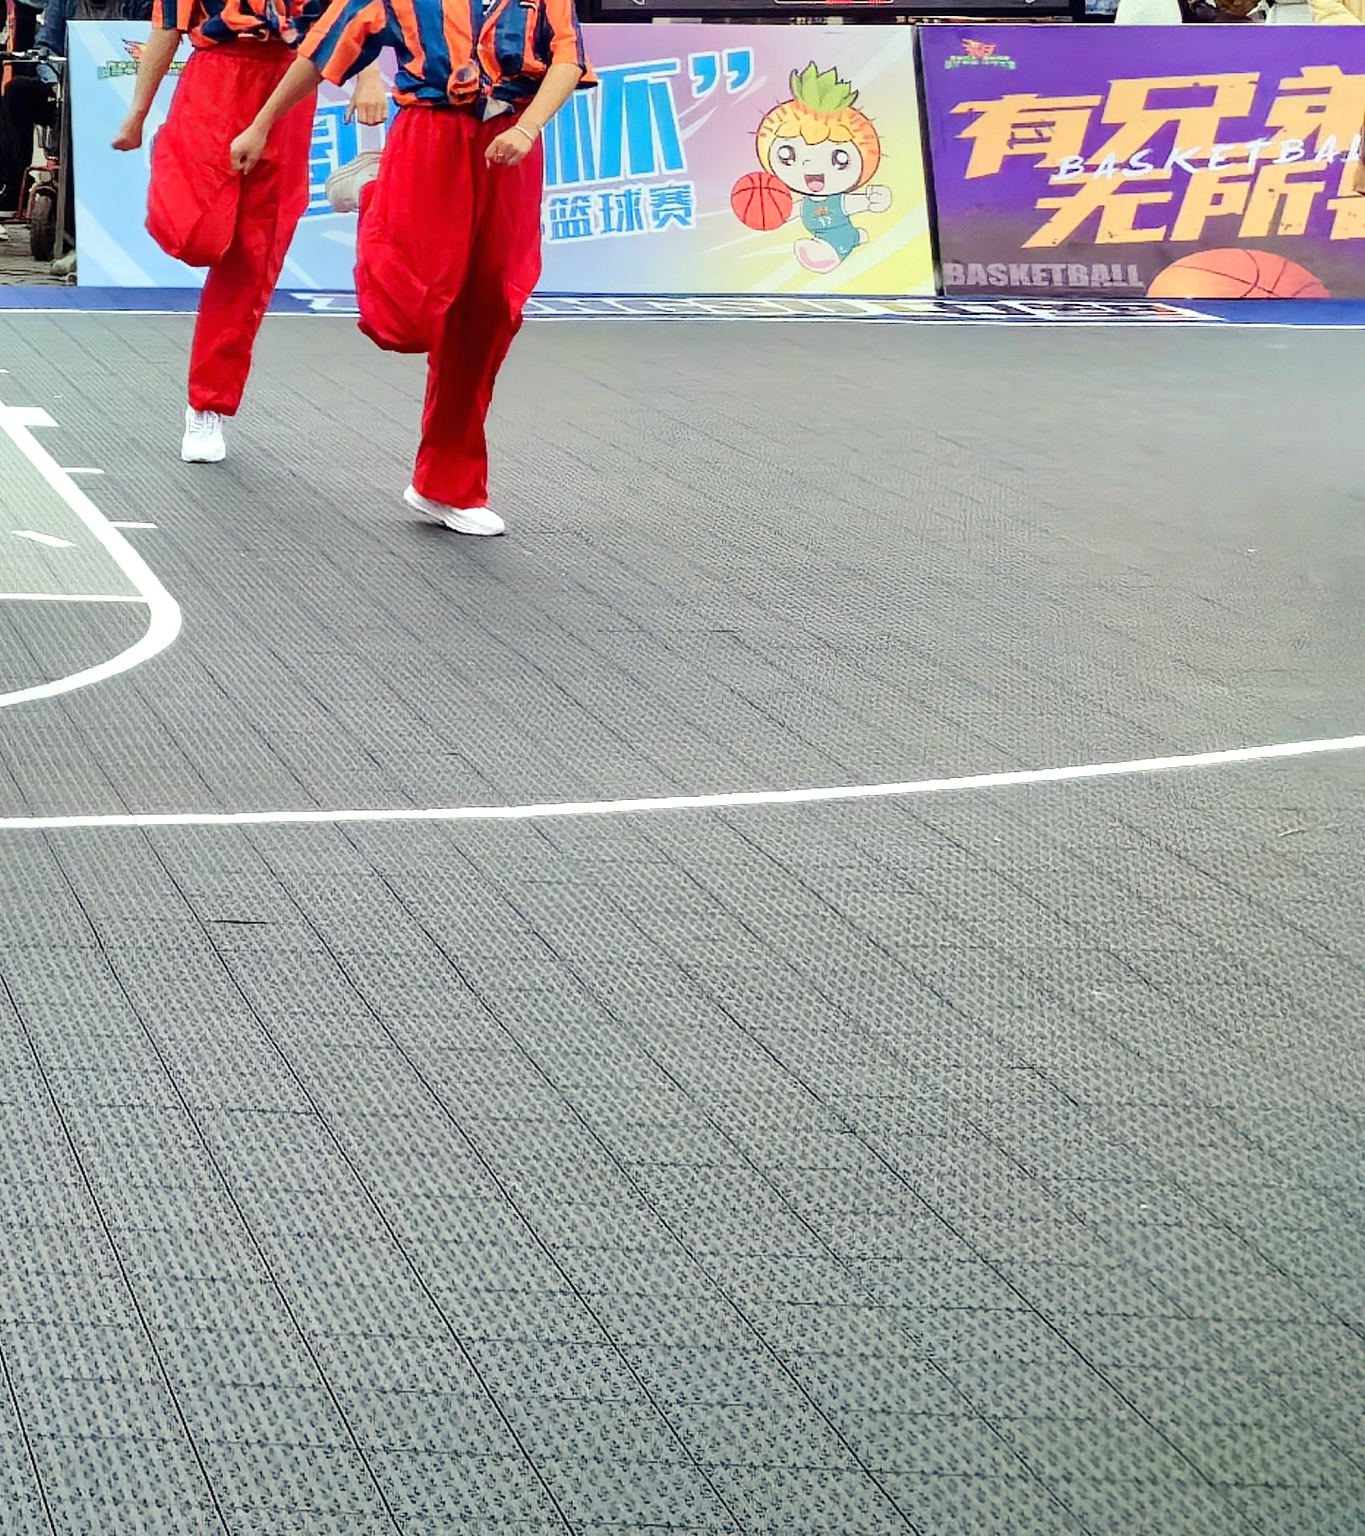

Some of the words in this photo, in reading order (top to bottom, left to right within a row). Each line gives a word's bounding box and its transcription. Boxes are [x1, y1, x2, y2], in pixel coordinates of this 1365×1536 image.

[547, 182, 697, 244] 篮球赛
[944, 261, 1146, 289] BASKETBALL
